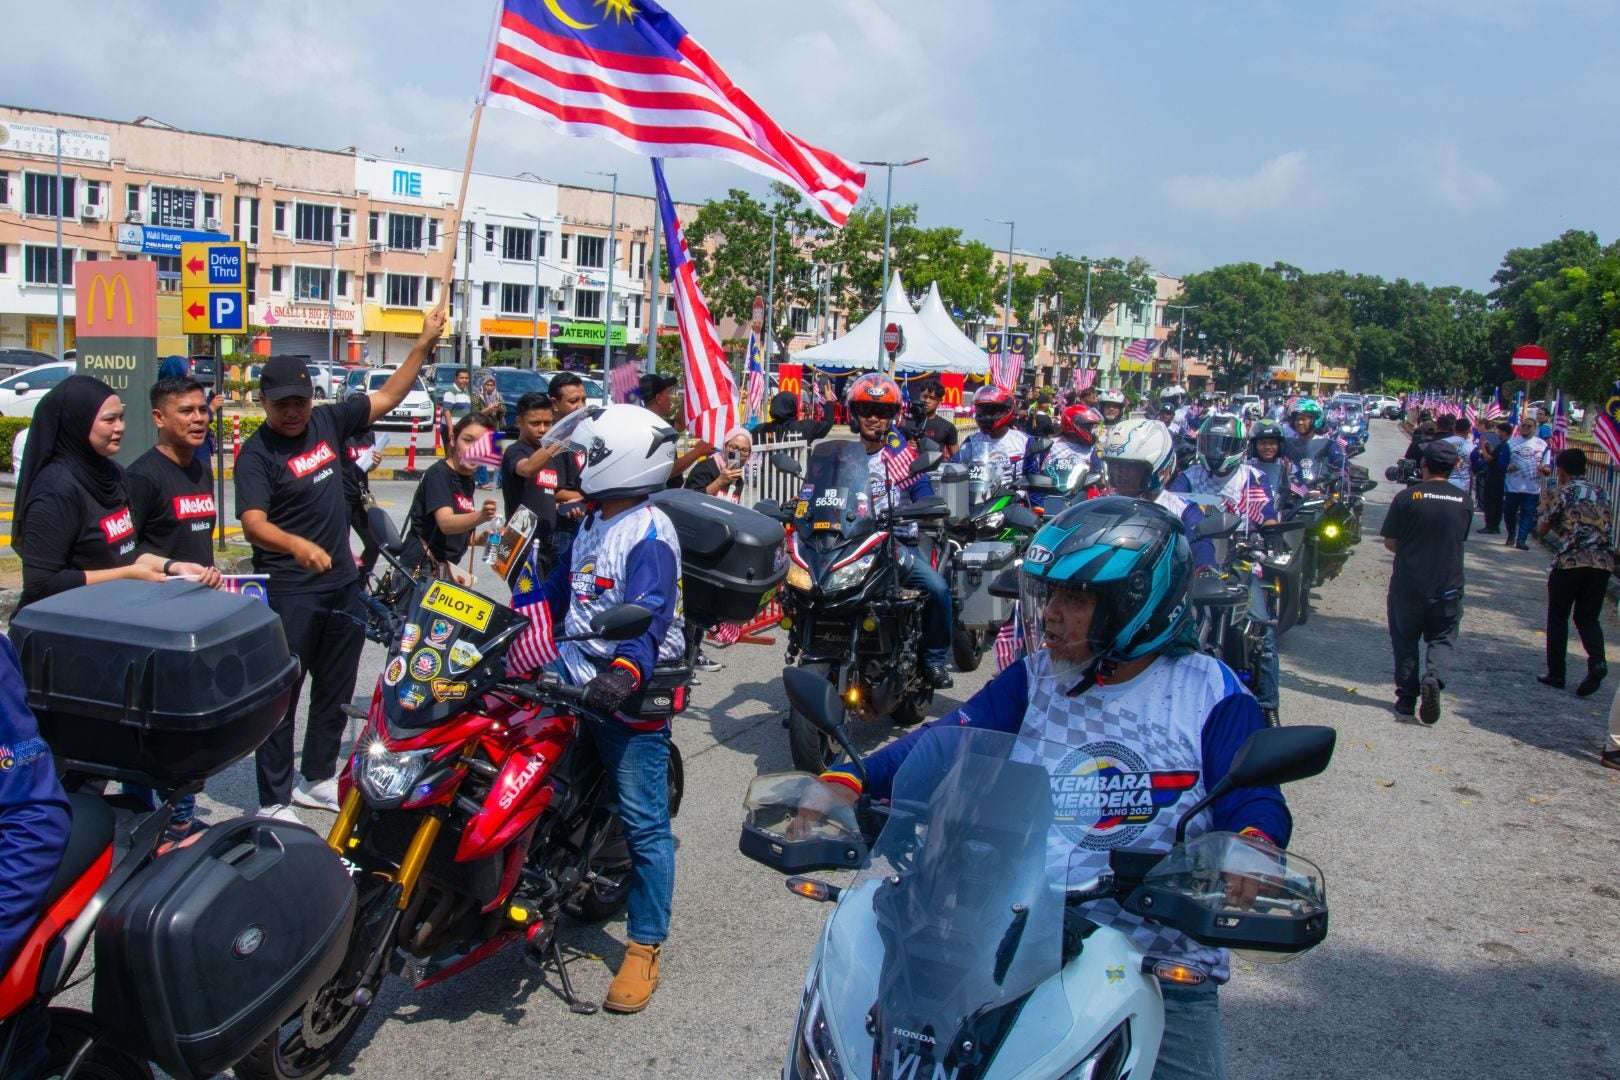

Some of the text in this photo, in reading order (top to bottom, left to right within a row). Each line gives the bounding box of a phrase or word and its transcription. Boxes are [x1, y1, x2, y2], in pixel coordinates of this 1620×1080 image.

[211, 254, 239, 265] Drive
[212, 266, 237, 277] Thru
[216, 297, 235, 324] P
[275, 305, 301, 318] SMALL
[302, 308, 307, 318] &
[308, 308, 322, 319] BIG
[84, 354, 137, 371] PANDU
[93, 374, 129, 390] ALU
[825, 488, 838, 497] WB
[438, 594, 486, 621] PILOT 5
[499, 752, 546, 810] SUZUKI
[1050, 774, 1152, 792] KEMBARA
[1051, 790, 1153, 809] MERDEKA
[1129, 806, 1153, 815] 2025
[893, 1027, 937, 1045] HONDA
